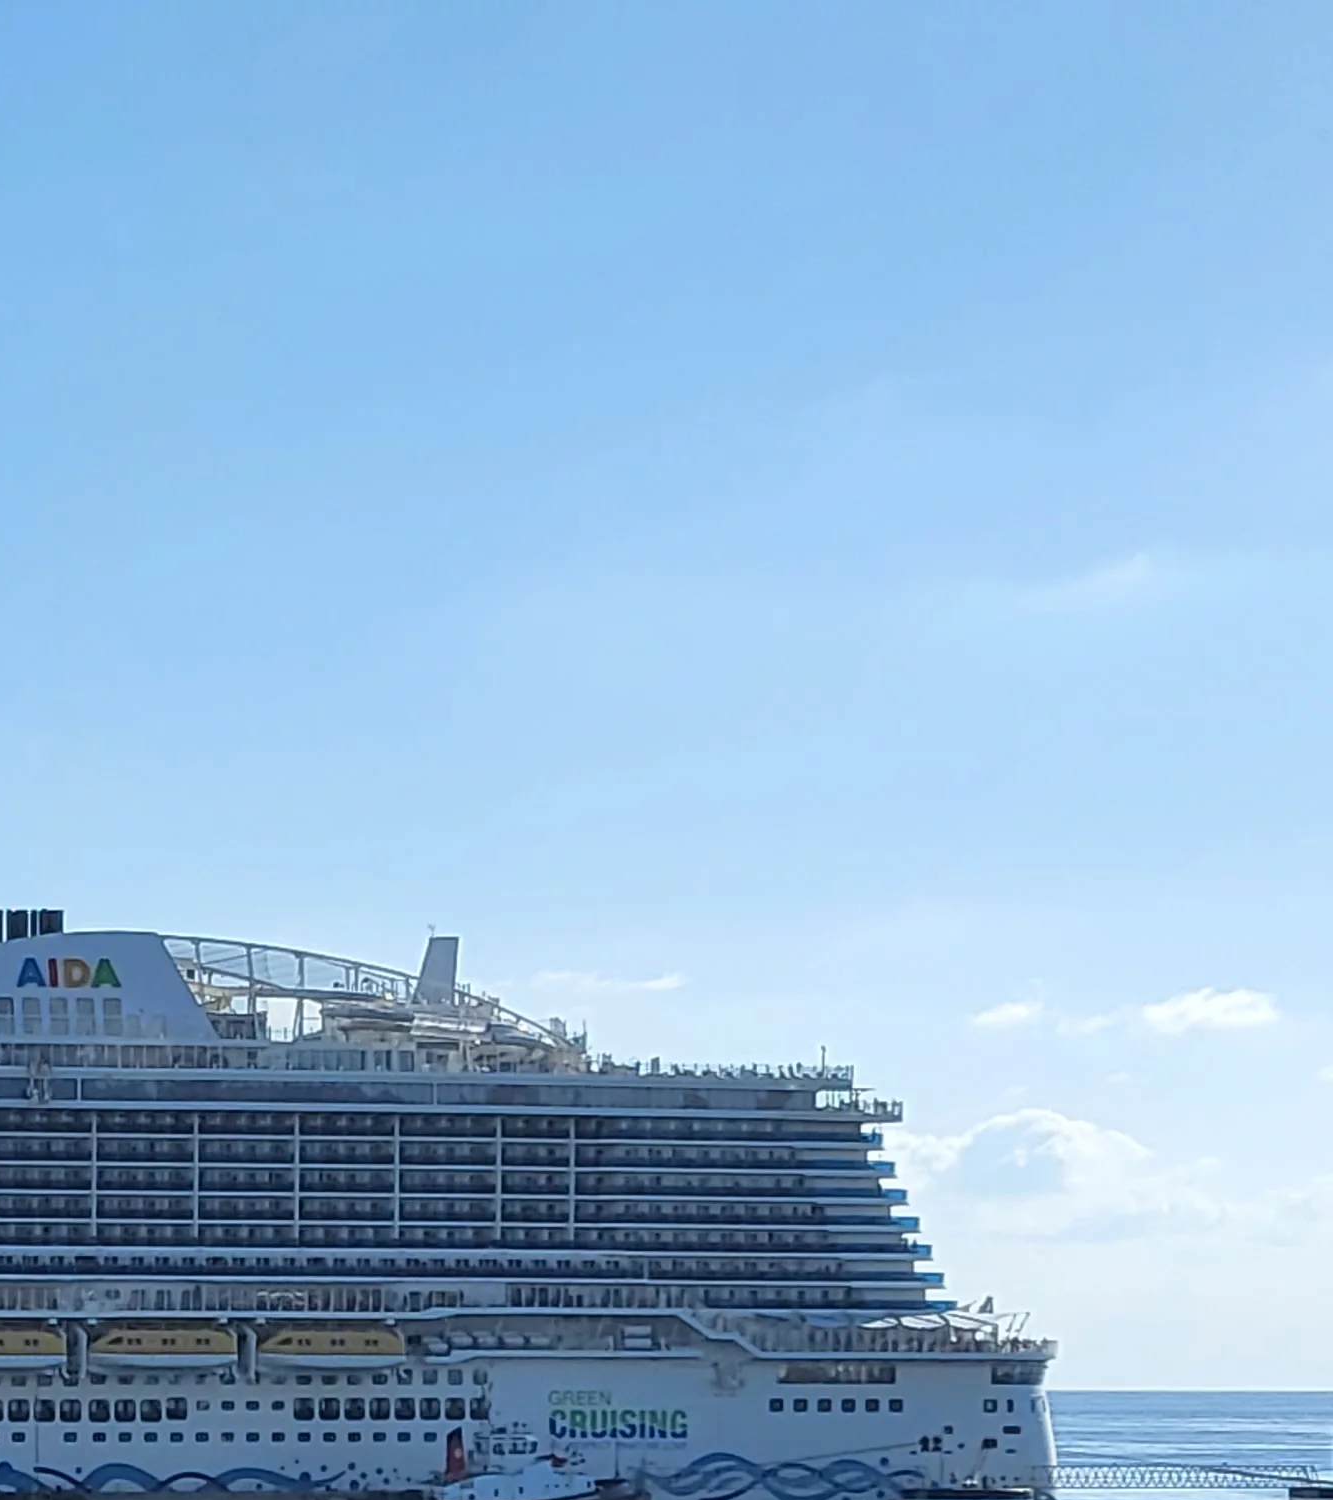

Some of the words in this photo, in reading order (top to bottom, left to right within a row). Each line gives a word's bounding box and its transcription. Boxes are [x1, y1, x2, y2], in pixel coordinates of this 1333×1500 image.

[16, 957, 121, 988] AIDA
[548, 1390, 612, 1406] GREEN
[549, 1409, 688, 1439] CRUISING
